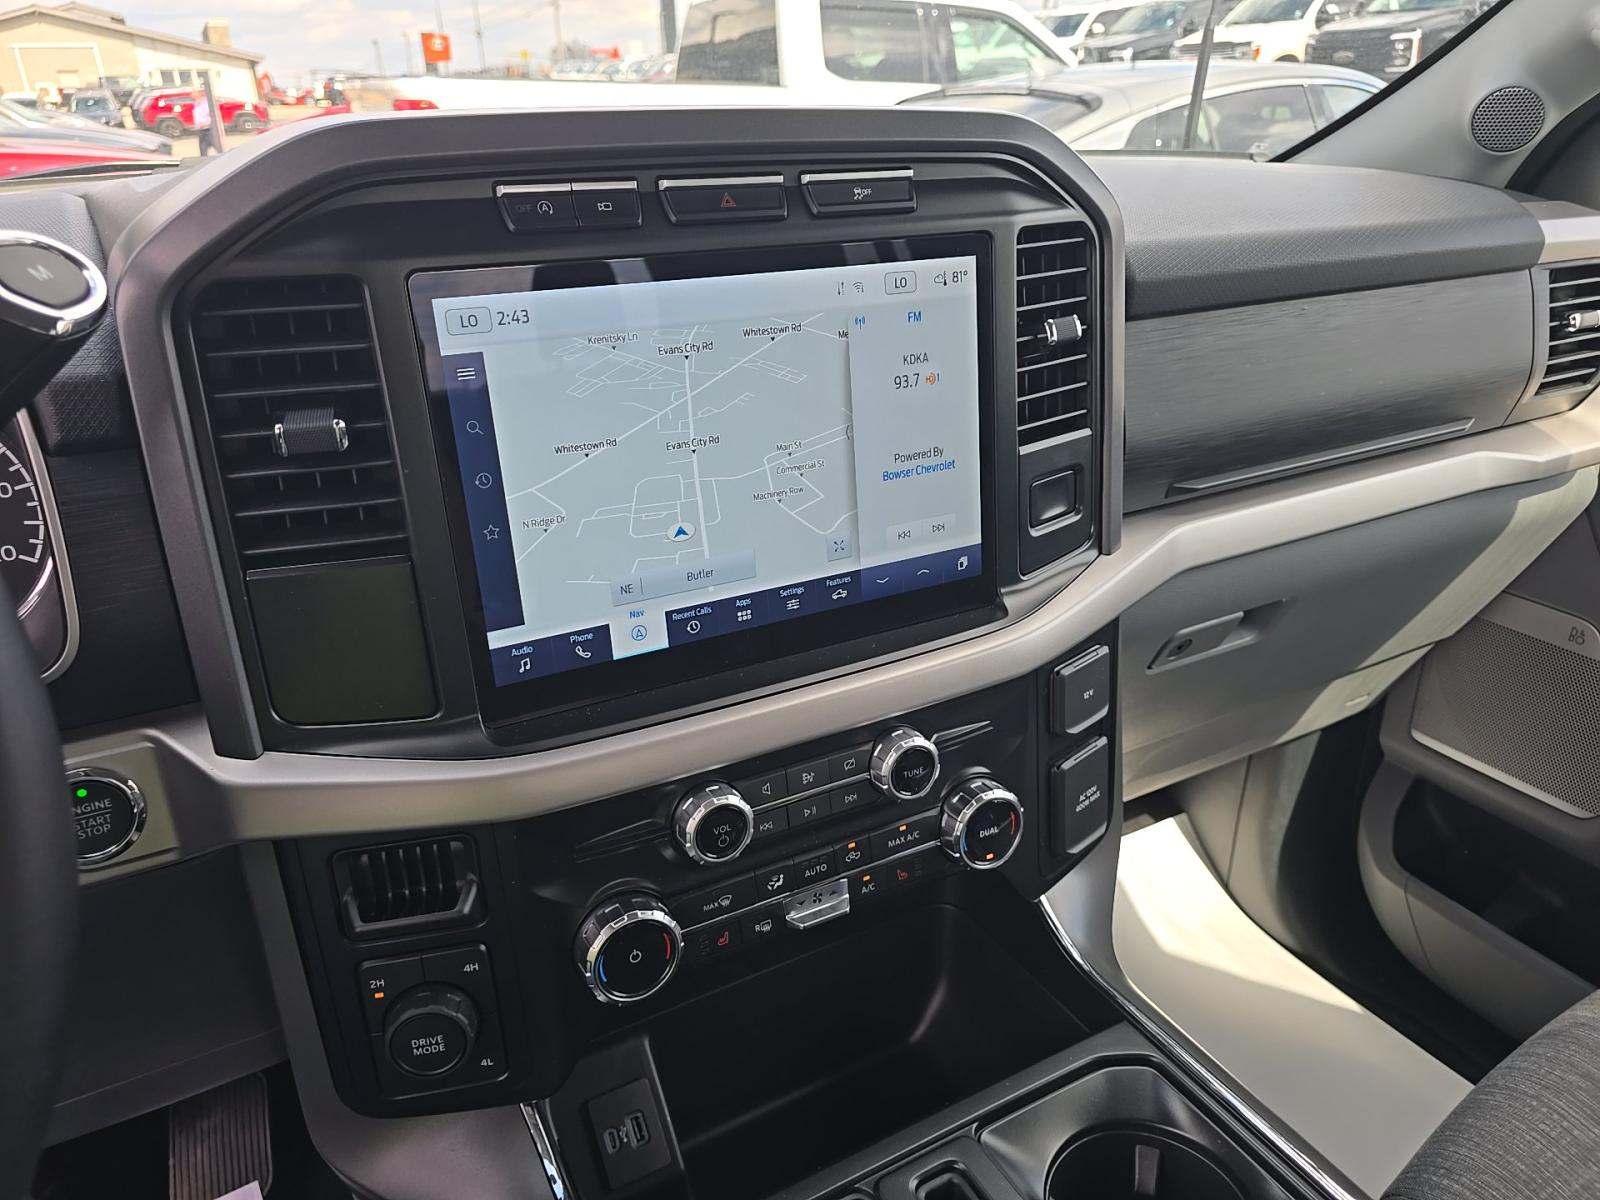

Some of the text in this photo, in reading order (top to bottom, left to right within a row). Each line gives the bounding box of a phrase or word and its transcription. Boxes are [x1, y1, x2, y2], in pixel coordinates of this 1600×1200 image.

[894, 276, 908, 289] LO
[460, 314, 478, 328] LO
[496, 310, 530, 326] 2:43
[908, 310, 922, 323] FM
[742, 322, 802, 338] Whitestown Rd
[587, 332, 639, 346] Krenitsky Ln
[658, 340, 714, 356] Evans City Rd
[903, 352, 928, 366] KDKA
[894, 373, 920, 390] 93.7
[554, 438, 618, 454] Whitestown Rd
[666, 434, 720, 452] Evans City Rd
[776, 441, 802, 452] Main St
[894, 447, 944, 464] Powered By
[776, 460, 825, 475] Commercial St
[882, 460, 956, 482] Bowser Chevrolet
[753, 487, 804, 502] Machinery Row
[522, 514, 566, 530] N Ridge Dr
[686, 568, 714, 582] Butler
[826, 576, 852, 587] Features
[620, 584, 634, 595] NE
[780, 585, 804, 598] Settings
[736, 598, 752, 609] Apps
[629, 609, 645, 620] Nav
[672, 606, 712, 622] Recent Calls
[570, 632, 594, 644] Phone
[511, 645, 534, 657] Audio
[903, 766, 925, 778] TUNE
[72, 798, 112, 814] NGINE
[78, 824, 111, 840] STOP
[714, 824, 732, 835] VOL
[980, 826, 1000, 838] DUAL
[888, 830, 920, 848] MAX A/C
[804, 863, 828, 878] AUTO
[861, 883, 876, 894] A/C
[703, 902, 720, 912] MAX
[463, 962, 480, 973] 4H
[369, 978, 385, 990] 2H
[411, 1034, 444, 1048] DRIVE
[413, 1043, 446, 1056] MODE
[480, 1058, 494, 1066] 4L
